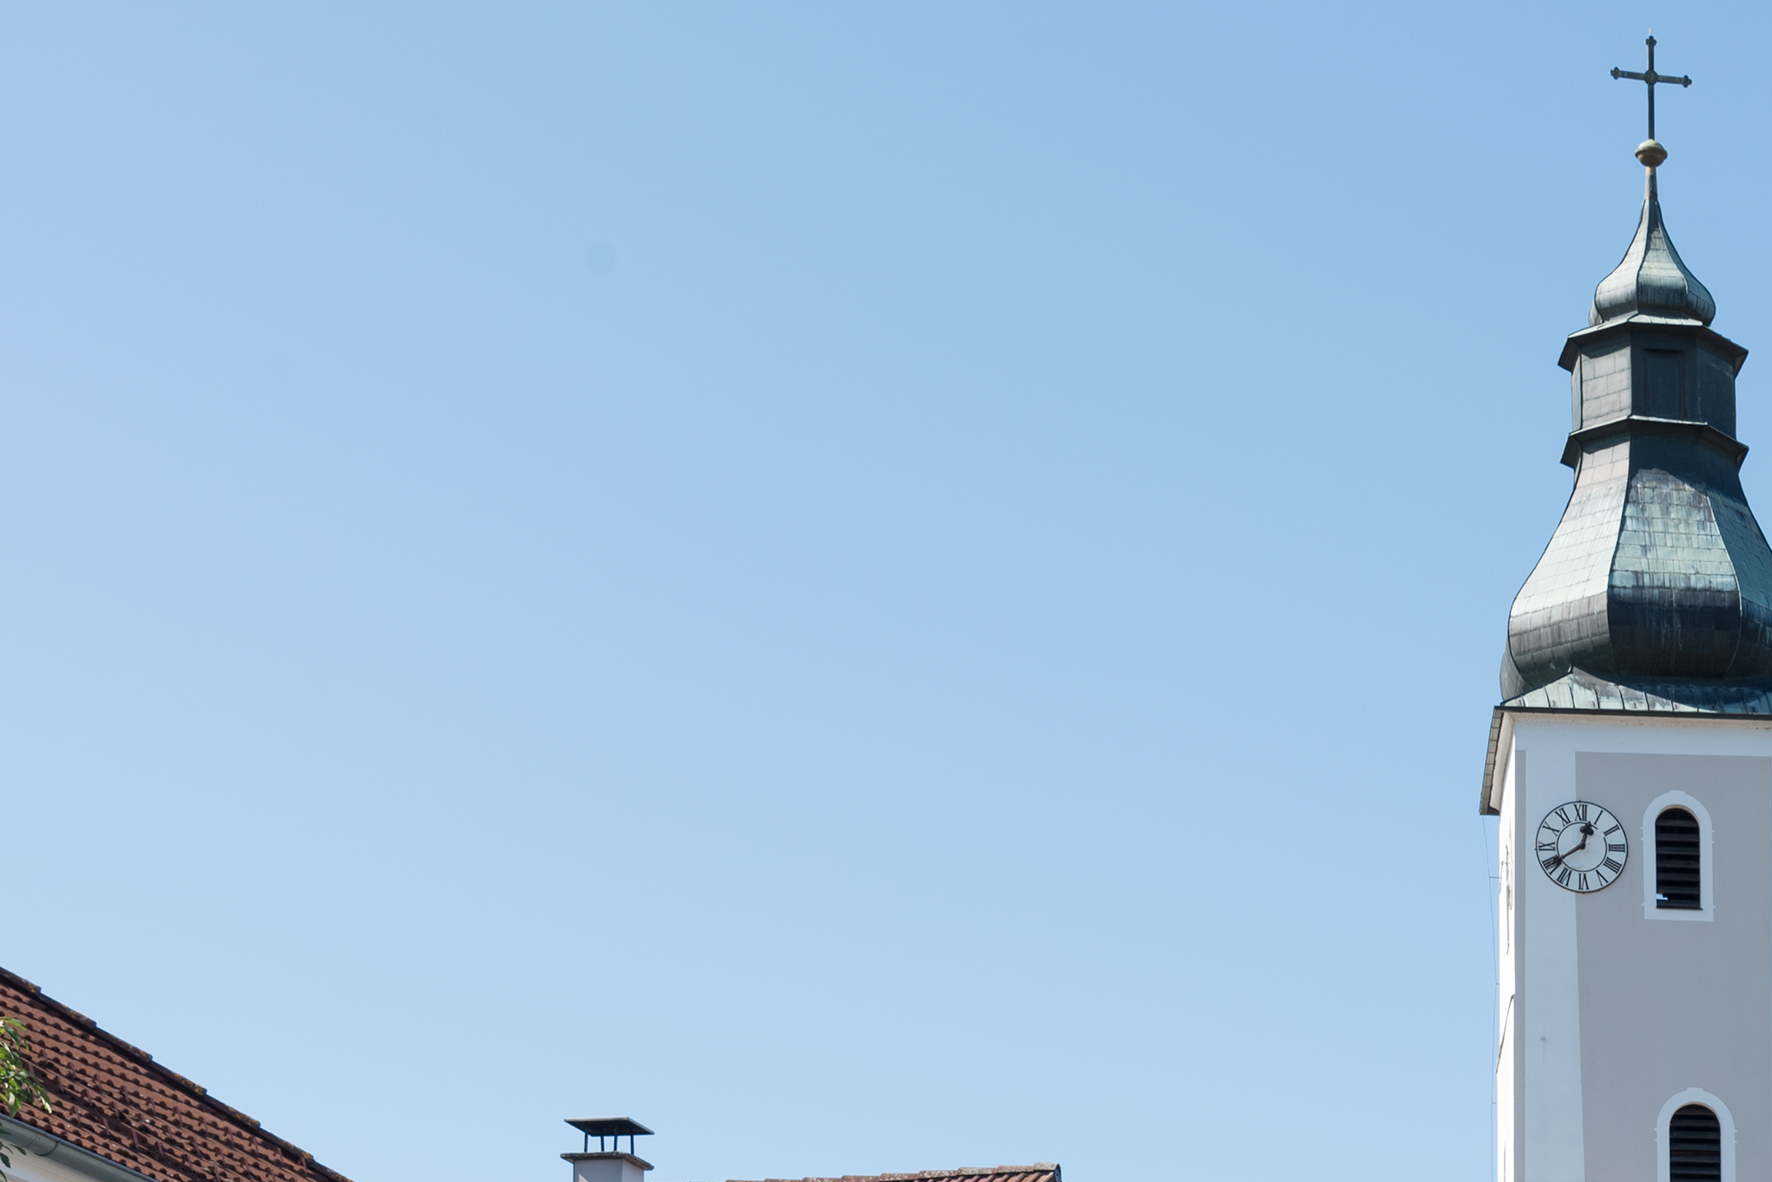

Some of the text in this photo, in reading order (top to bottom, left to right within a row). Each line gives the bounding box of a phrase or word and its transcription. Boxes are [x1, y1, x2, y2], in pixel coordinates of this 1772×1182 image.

[1555, 807, 1571, 826] XI
[1574, 804, 1588, 821] XII
[1594, 810, 1603, 825] I
[1542, 821, 1560, 836] X
[1603, 824, 1620, 836] II
[1538, 841, 1555, 852] IX
[1608, 843, 1625, 852] III
[1556, 867, 1572, 886] VII
[1578, 873, 1589, 890] VI
[1595, 869, 1609, 886] V
